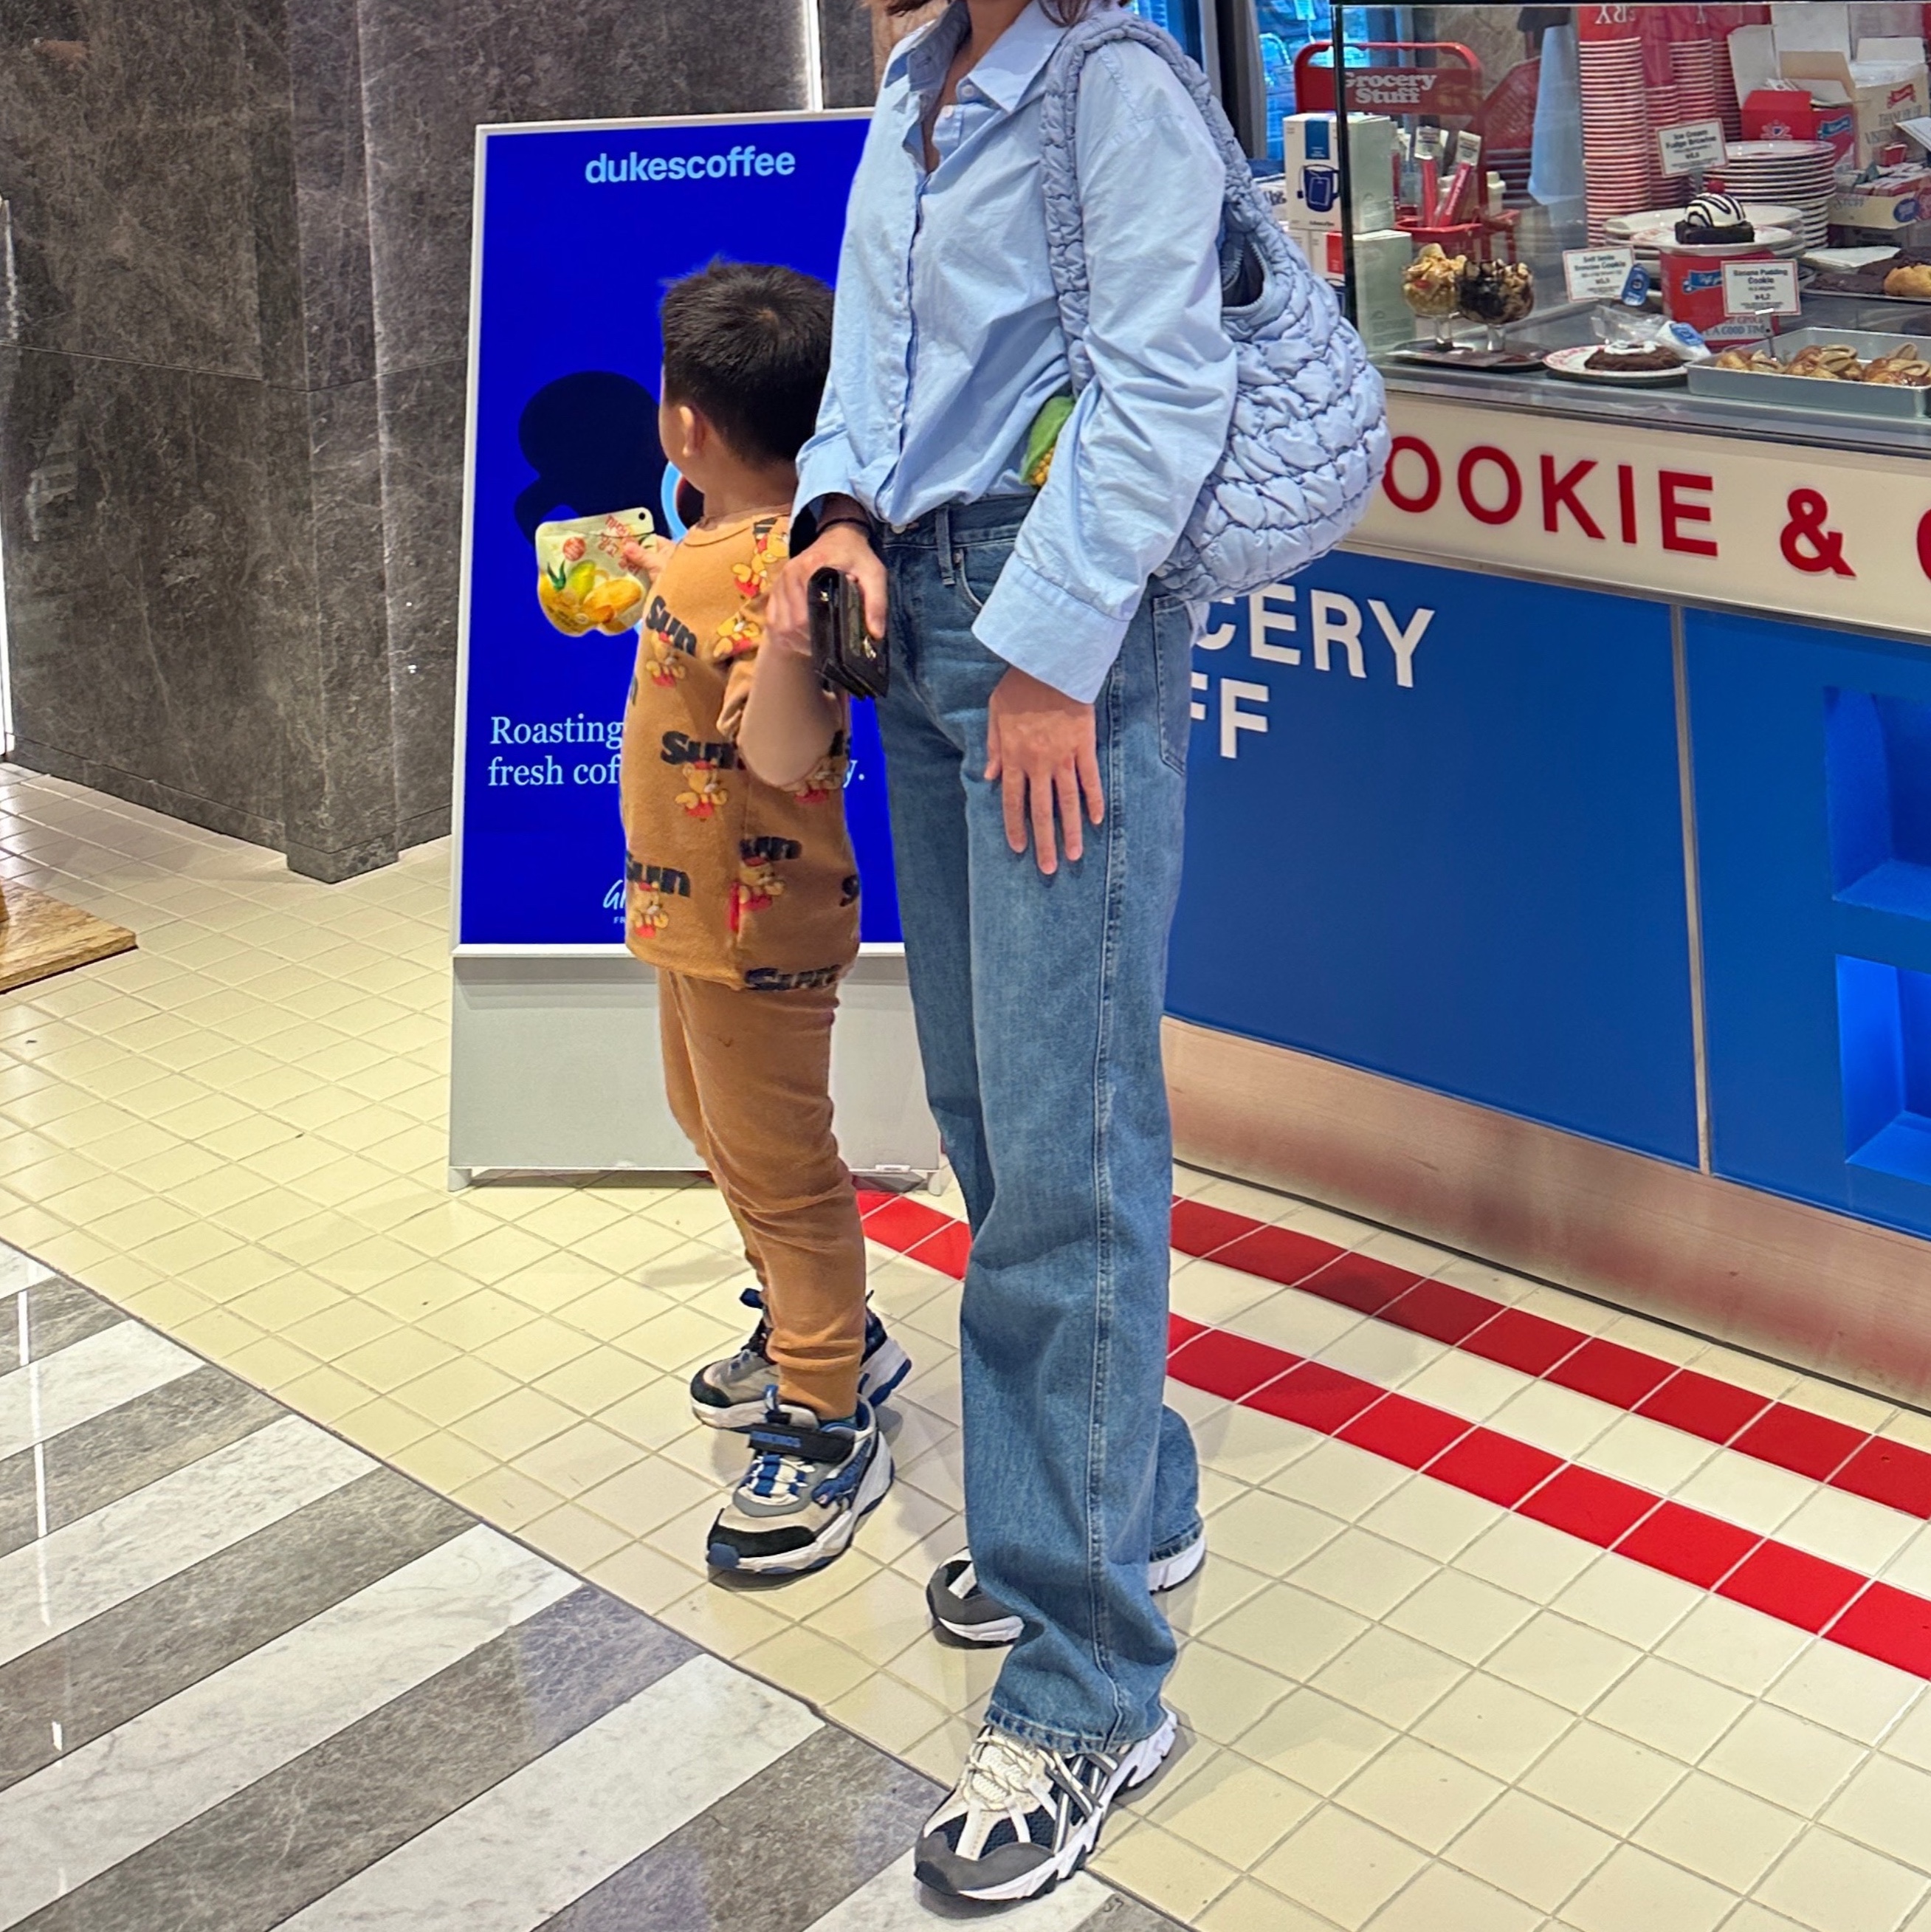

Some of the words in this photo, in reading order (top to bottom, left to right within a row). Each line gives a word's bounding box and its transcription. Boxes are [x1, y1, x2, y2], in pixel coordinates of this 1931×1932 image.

[1355, 87, 1421, 104] Stuff
[585, 145, 796, 183] dukescoffee
[1748, 276, 1775, 284] Cookie
[1780, 488, 1857, 578] &
[489, 712, 624, 750] Roasting
[487, 755, 565, 786] fresh
